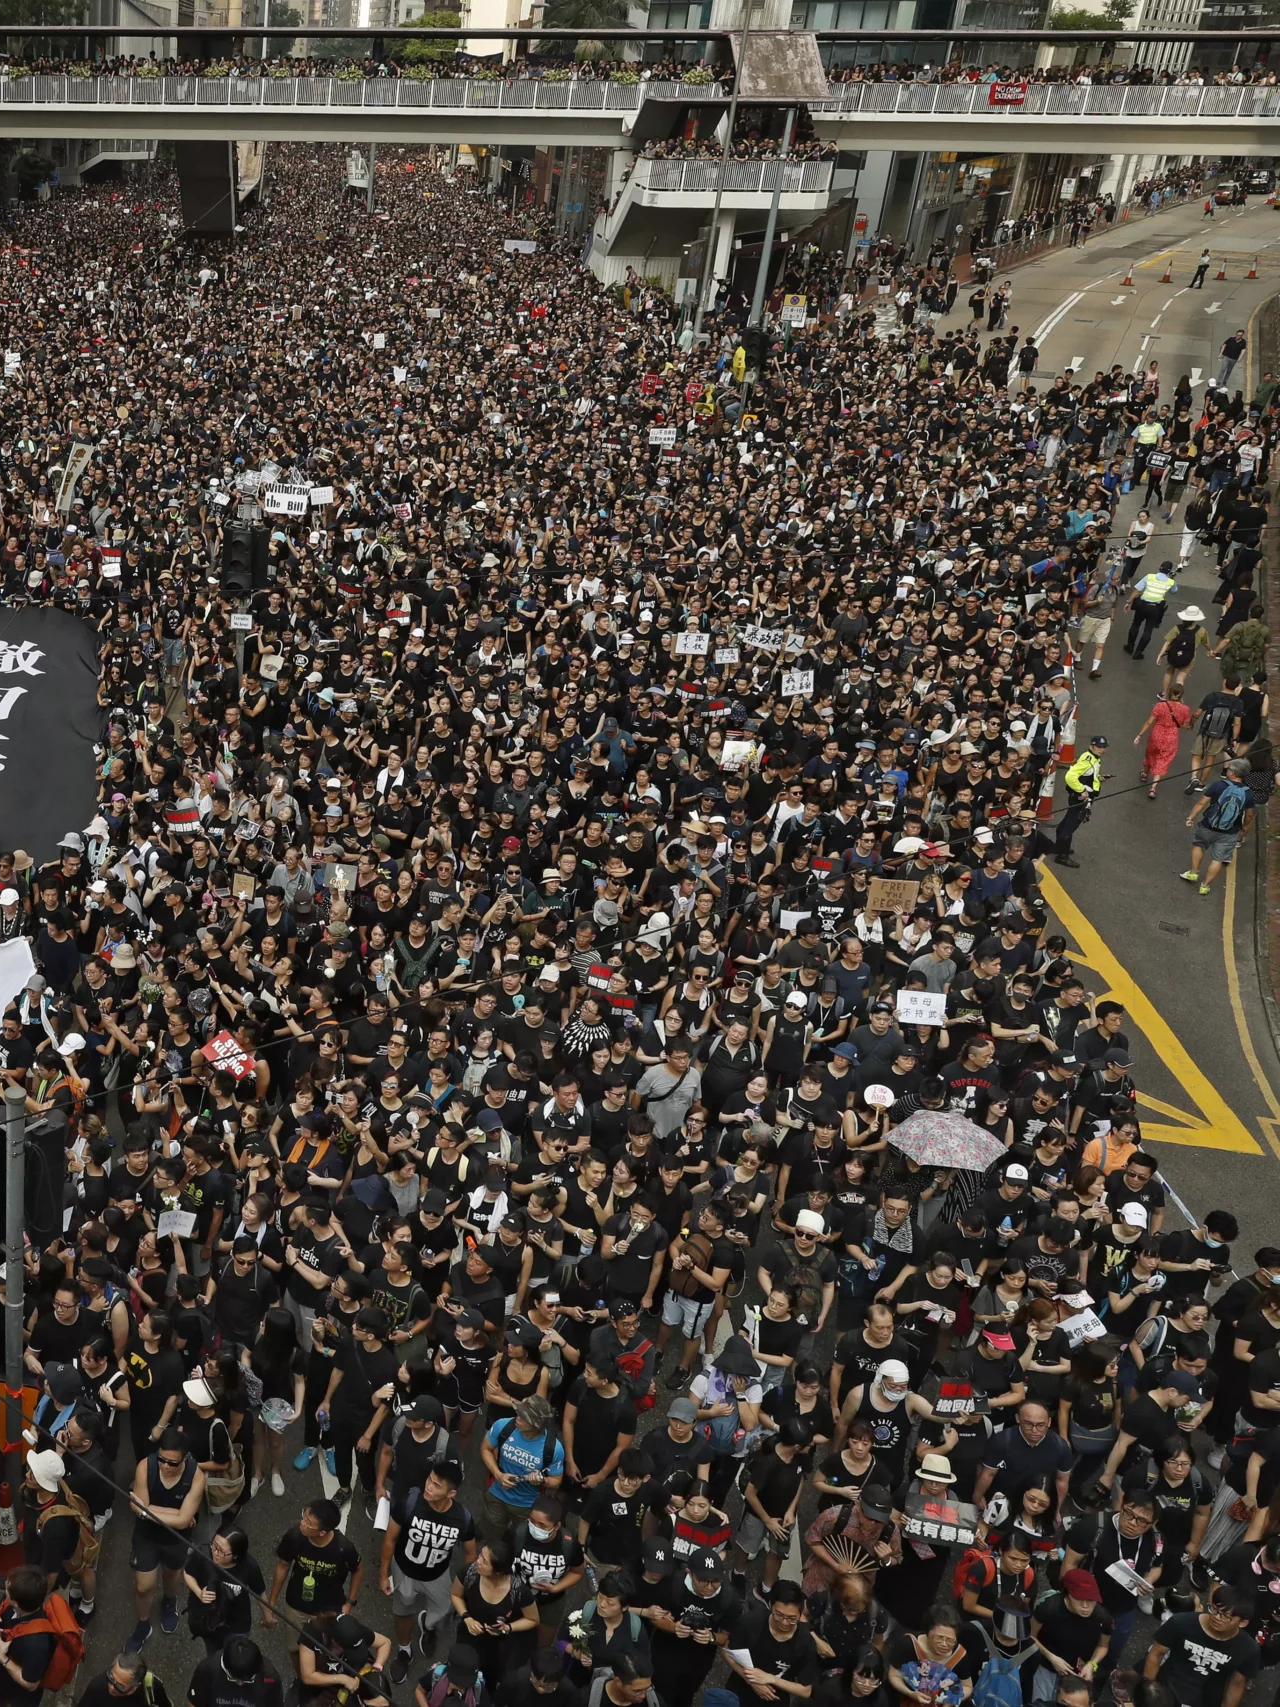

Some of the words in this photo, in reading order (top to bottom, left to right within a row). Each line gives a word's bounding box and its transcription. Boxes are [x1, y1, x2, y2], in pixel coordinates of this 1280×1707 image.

[266, 482, 310, 496] Withdraw
[266, 495, 281, 508] the
[287, 500, 303, 512] Bill
[880, 881, 906, 891] FREE
[885, 891, 903, 899] THE
[910, 996, 932, 1007] 慈母
[903, 1007, 938, 1019] 不持武
[211, 1041, 245, 1076] KILLING
[224, 1037, 249, 1062] STOP
[502, 1443, 541, 1464] SPORTS
[502, 1450, 536, 1469] MAGIC
[411, 1515, 460, 1539] NEVER
[905, 1518, 975, 1545] 沒有暴動
[408, 1528, 456, 1551] GIVE
[404, 1538, 449, 1568] UP
[520, 1548, 566, 1567] NEVER
[704, 1557, 715, 1569] NY
